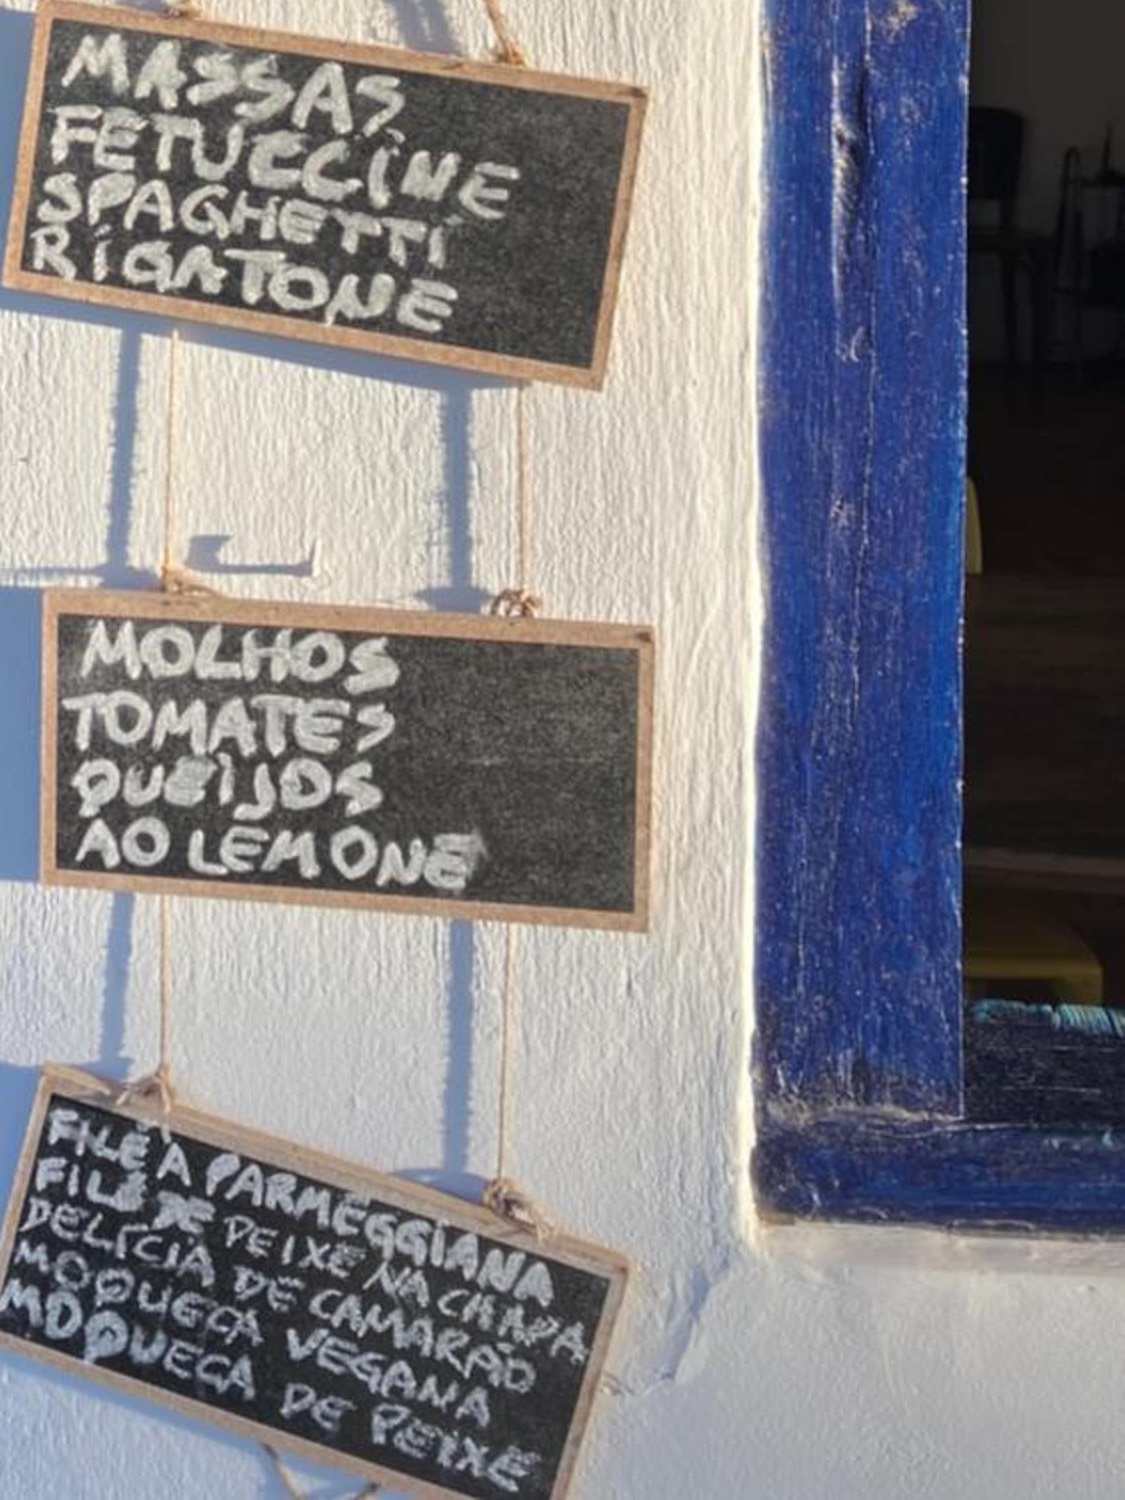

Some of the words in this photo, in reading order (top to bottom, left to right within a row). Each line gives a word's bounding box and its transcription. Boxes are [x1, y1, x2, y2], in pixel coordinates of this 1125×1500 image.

[61, 33, 406, 137] MASSAS
[36, 172, 464, 270] SPAGHETTI
[29, 225, 461, 334] RIGATONE
[81, 619, 401, 695] MOLHOS
[62, 690, 397, 756] TOMATES
[72, 752, 384, 821] QUEIJOS
[75, 817, 171, 868] AO
[151, 1188, 216, 1234] DE
[205, 1152, 555, 1309] PARMEGGIANA
[278, 1381, 357, 1432] DE
[285, 1328, 491, 1429] VEGANA
